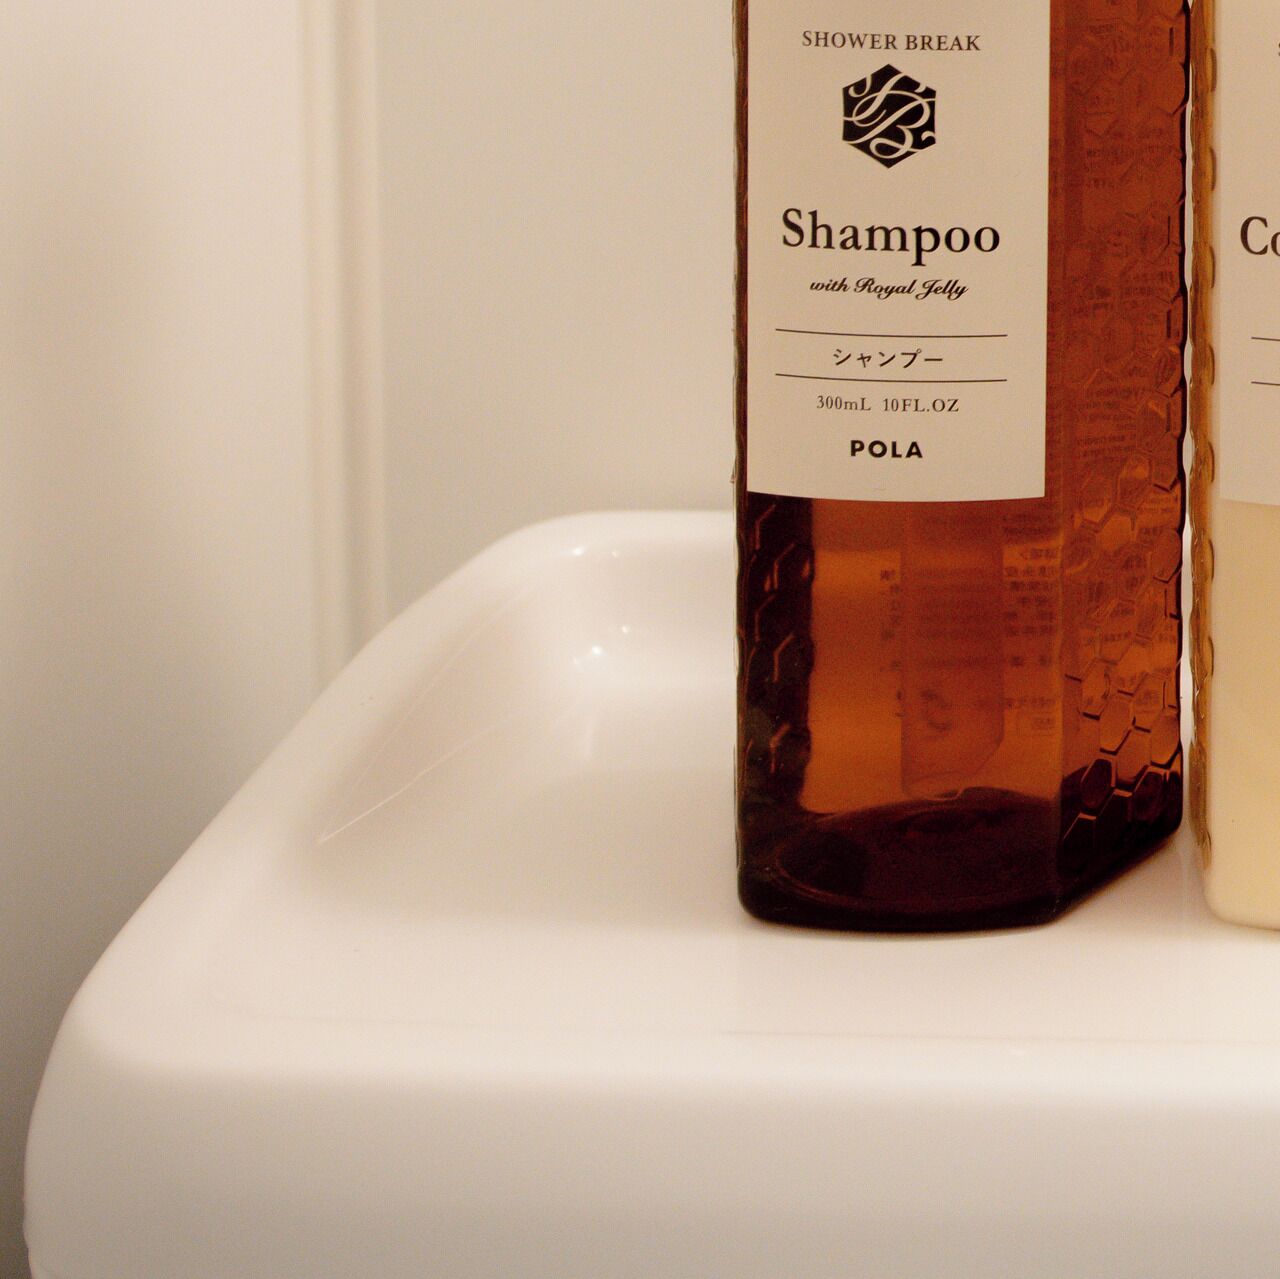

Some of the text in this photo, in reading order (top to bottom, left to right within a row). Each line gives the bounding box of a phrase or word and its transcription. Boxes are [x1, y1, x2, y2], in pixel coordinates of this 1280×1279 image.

[803, 31, 980, 50] SHOWER BREAK
[783, 208, 999, 266] Shampoo
[810, 278, 968, 300] with Royal Jelly
[834, 349, 943, 368] シャンプー
[817, 396, 958, 411] 300mL 10FL.OZ
[851, 440, 922, 458] POLA
